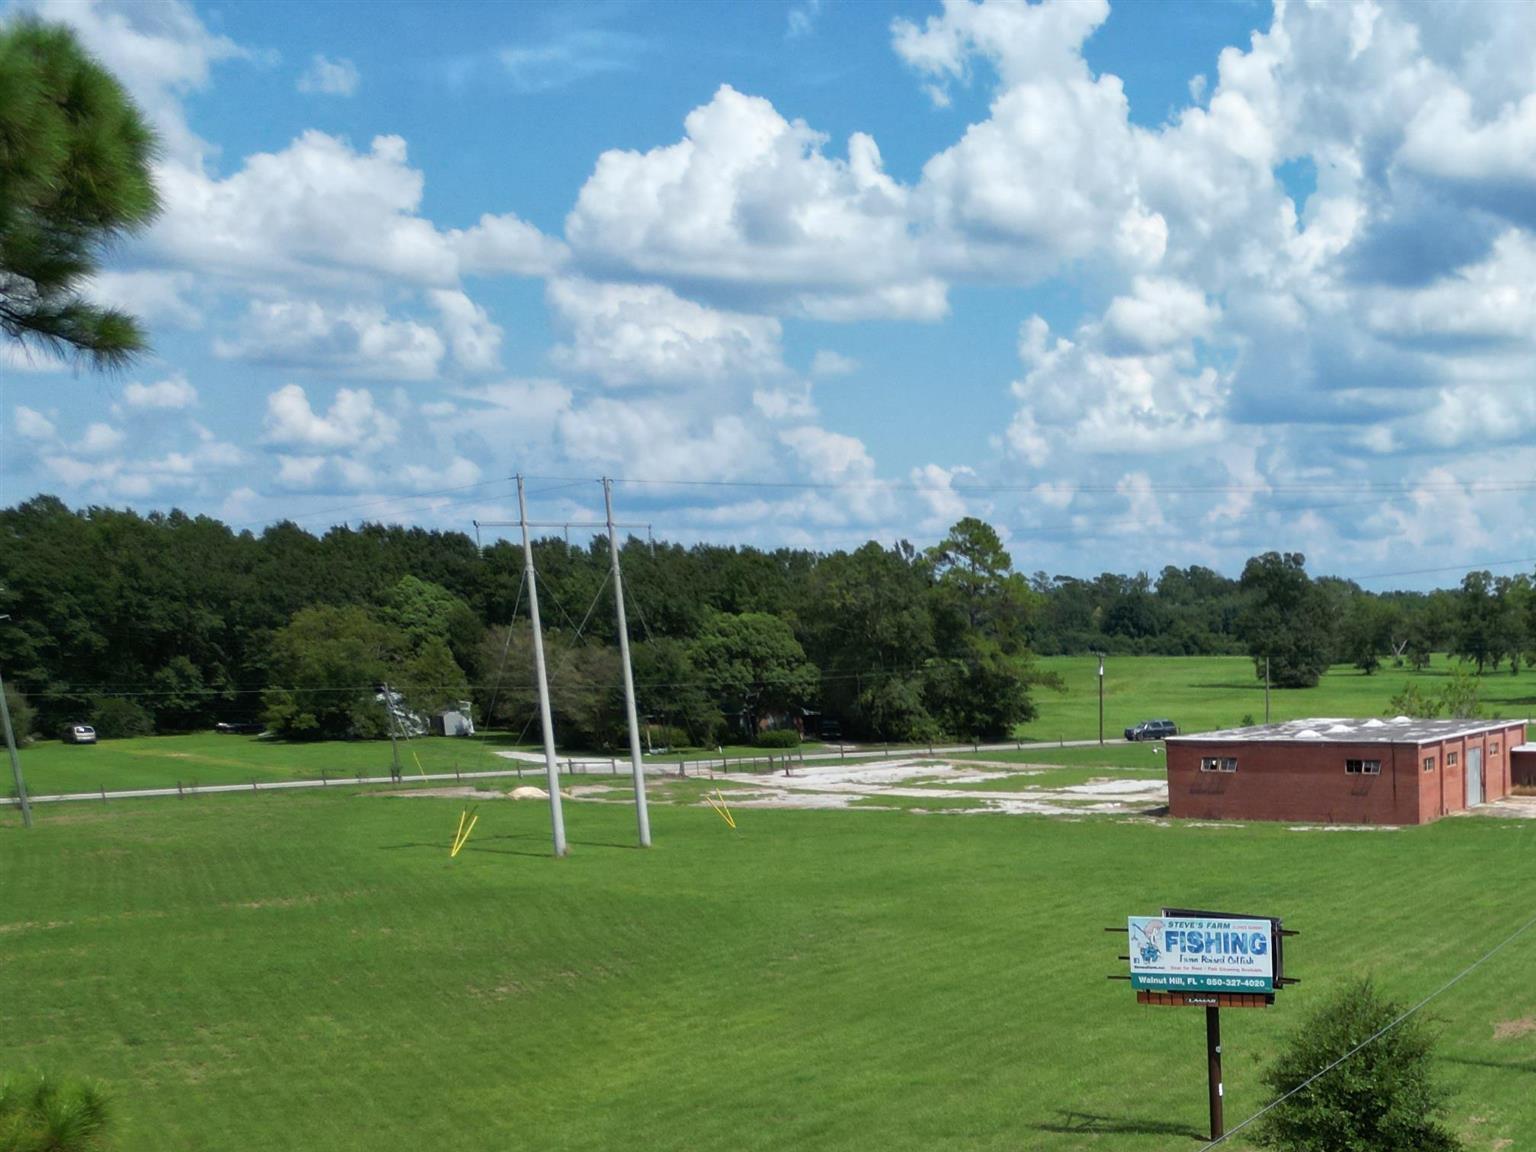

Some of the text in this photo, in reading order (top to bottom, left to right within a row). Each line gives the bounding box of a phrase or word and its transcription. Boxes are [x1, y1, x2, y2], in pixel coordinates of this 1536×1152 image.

[1168, 920, 1203, 929] STEVE'S
[1206, 922, 1231, 930] FARM
[1165, 931, 1267, 955] FISHING
[1138, 976, 1167, 985] Walnut
[1169, 977, 1185, 986] Hill,
[1187, 978, 1198, 986] FL
